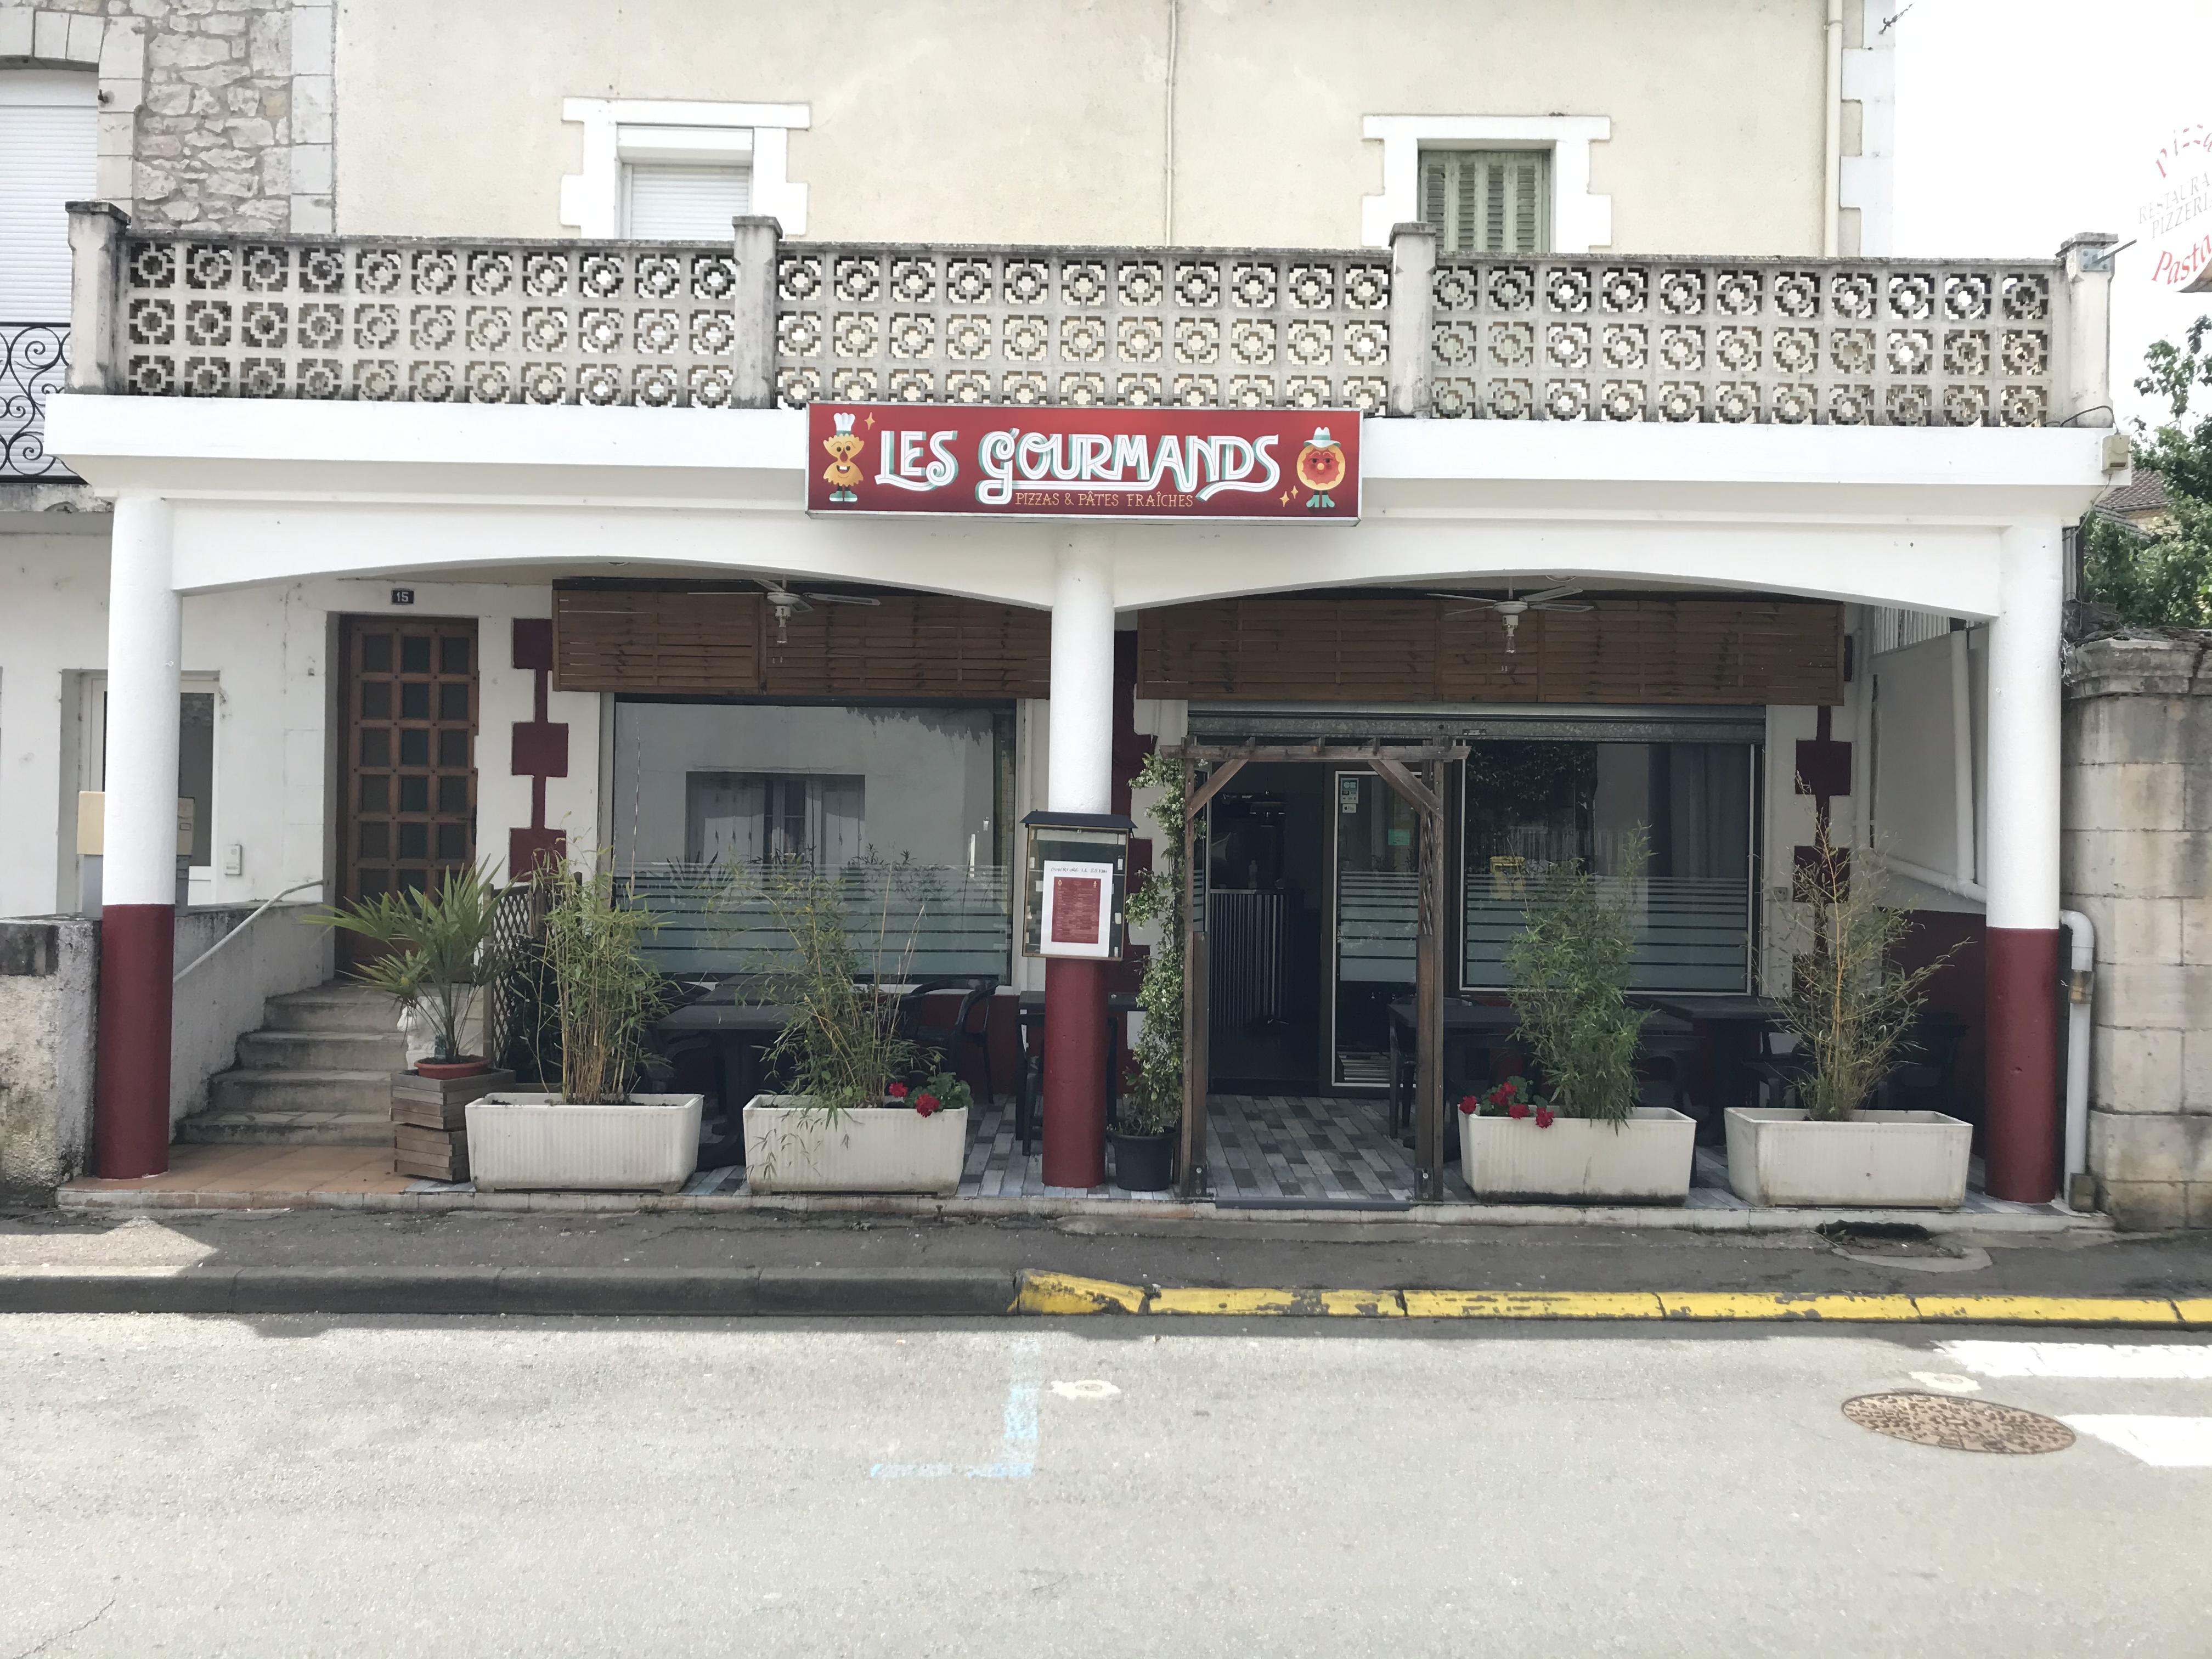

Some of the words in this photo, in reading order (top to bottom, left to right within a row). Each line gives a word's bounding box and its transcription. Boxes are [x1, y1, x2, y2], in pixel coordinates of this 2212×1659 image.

[2139, 171, 2212, 224] RESTAURA
[2152, 192, 2212, 239] PIZZERI
[874, 430, 958, 492] LES
[975, 427, 1280, 505] GOURMANDS
[1015, 493, 1060, 505] PIZZAS
[1064, 492, 1074, 505] &
[1078, 490, 1119, 506] PÂTES
[1126, 491, 1193, 507] FRAÎCHES
[397, 591, 409, 602] 15
